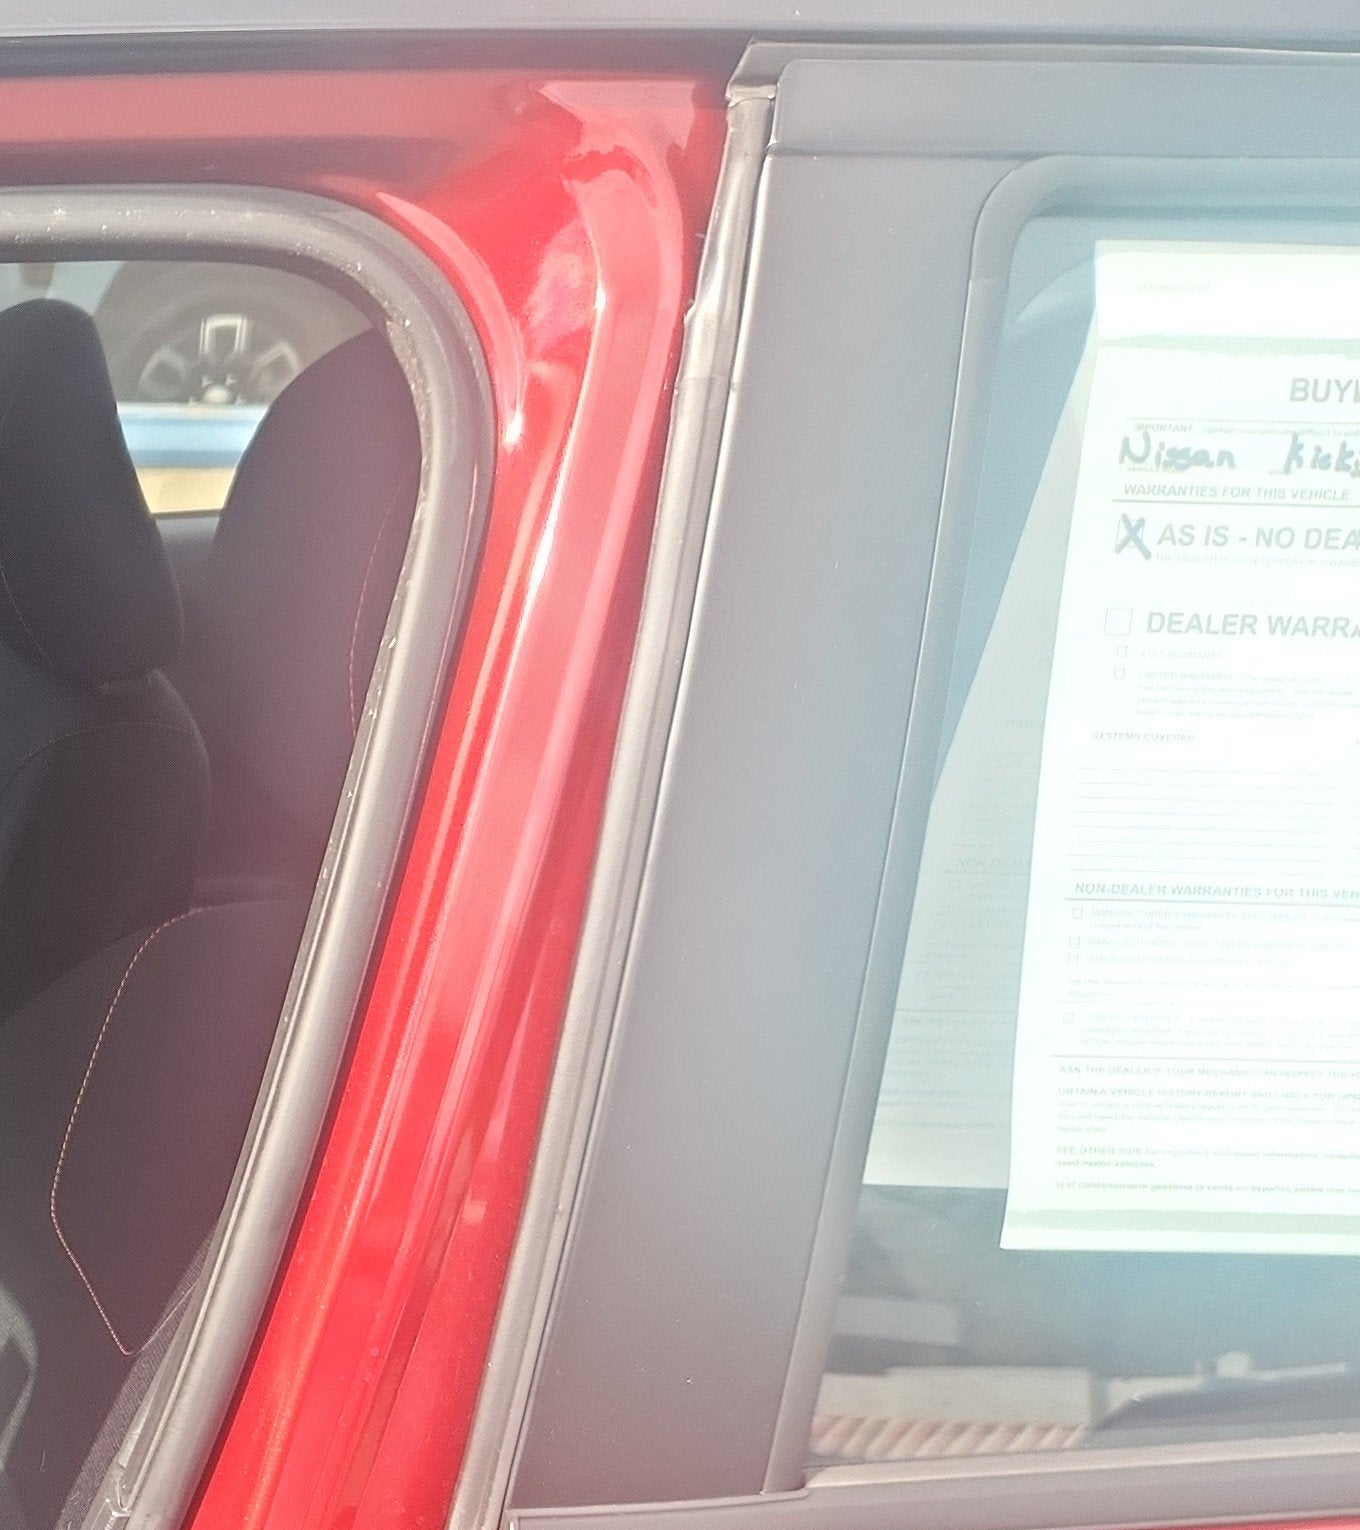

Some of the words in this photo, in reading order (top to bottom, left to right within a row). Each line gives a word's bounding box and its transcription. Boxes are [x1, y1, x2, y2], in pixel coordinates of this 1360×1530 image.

[1124, 483, 1218, 498] WARRANTIES
[1222, 486, 1251, 498] FOR
[1257, 487, 1286, 500] THIS
[1157, 523, 1195, 547] AS
[1204, 525, 1230, 547] IS
[1255, 527, 1295, 549] NO
[1304, 528, 1360, 551] DEA
[1146, 611, 1258, 636] DEALER
[1075, 882, 1167, 896] NON-DEALER
[1171, 885, 1262, 898] WARRANTIES
[1267, 888, 1293, 898] FOR
[1299, 888, 1328, 899] THIS
